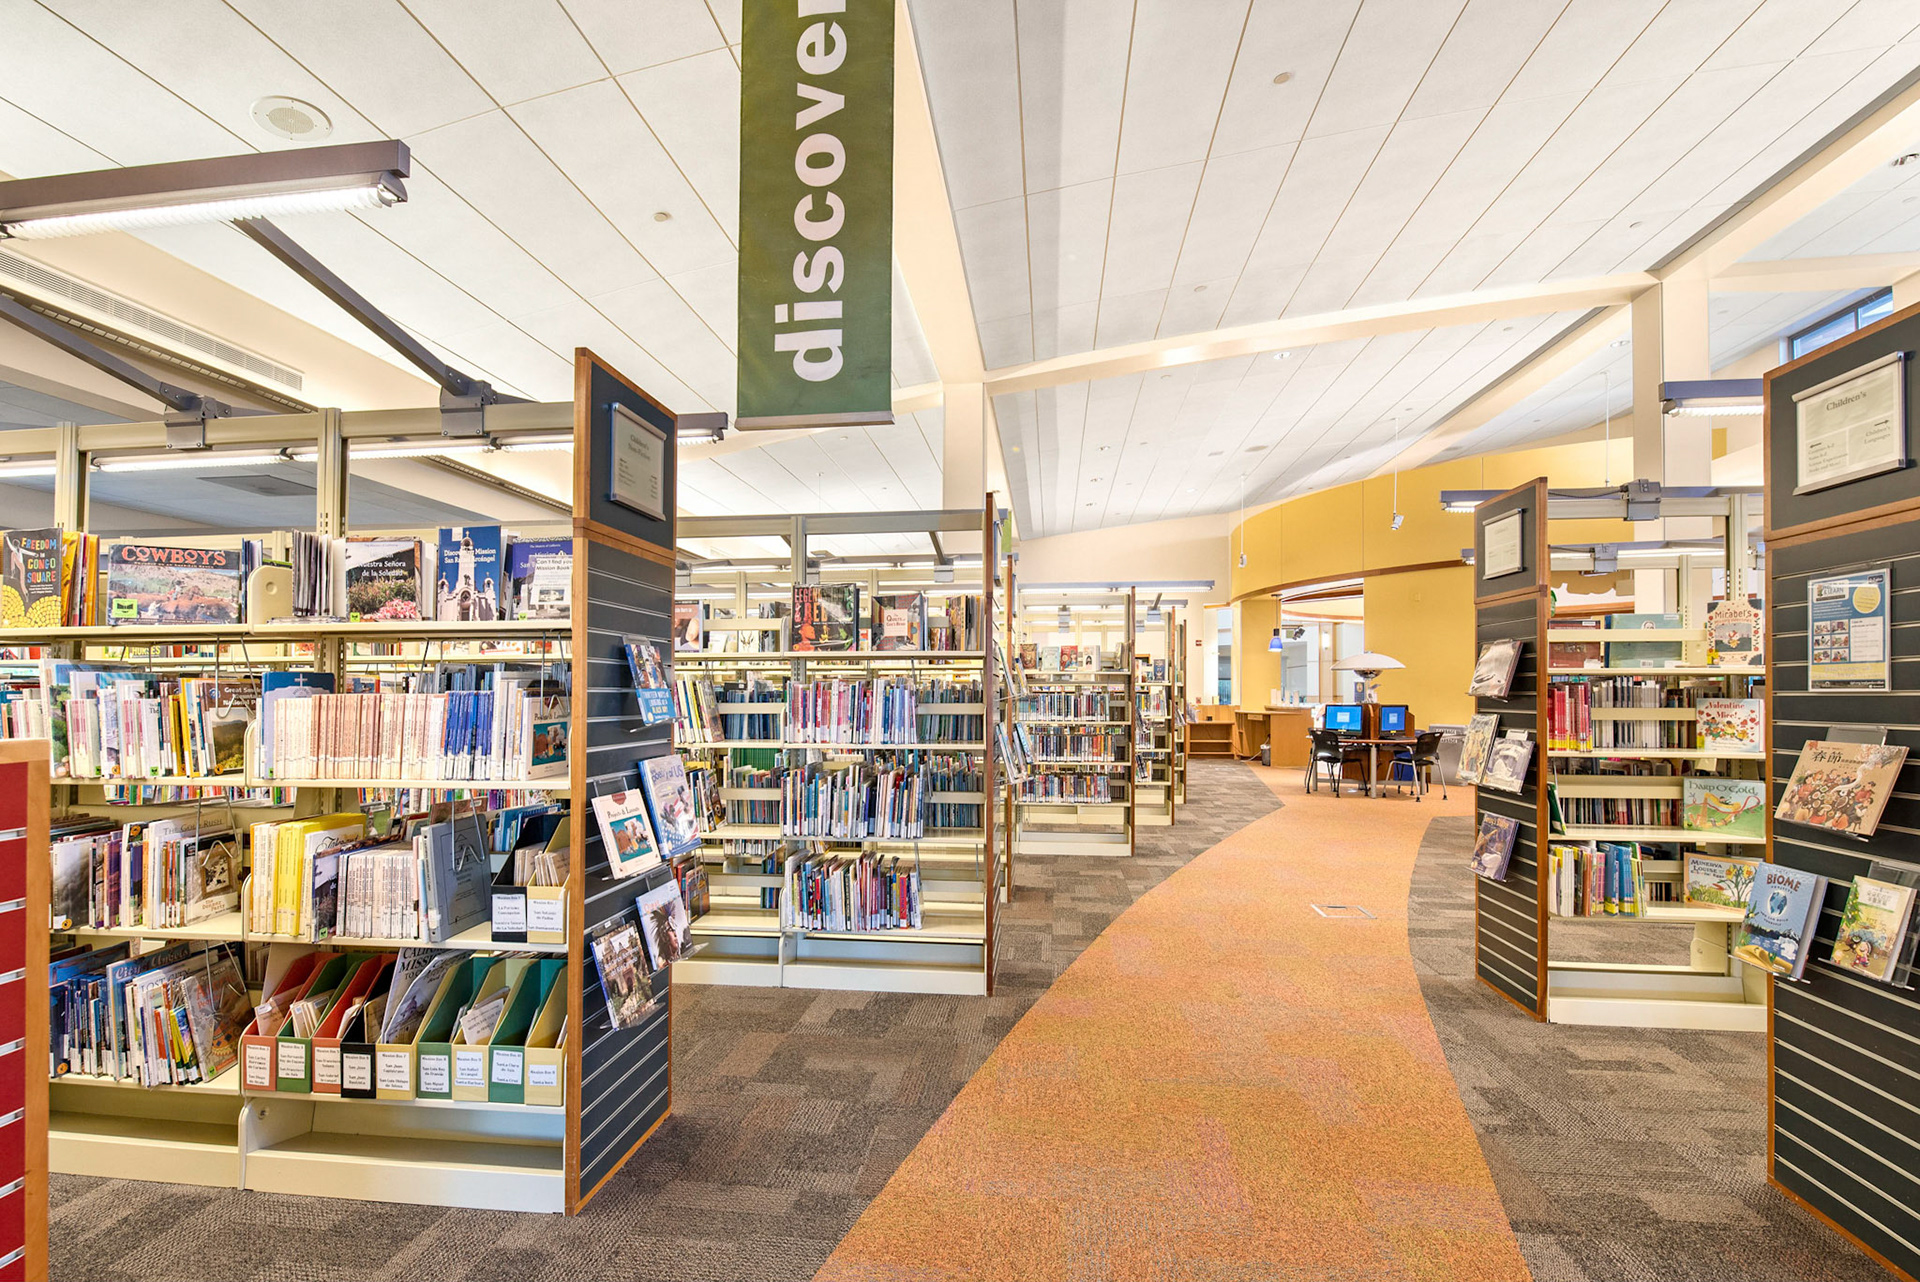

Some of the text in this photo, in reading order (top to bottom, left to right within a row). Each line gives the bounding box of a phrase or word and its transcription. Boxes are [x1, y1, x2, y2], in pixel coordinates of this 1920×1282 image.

[1826, 390, 1868, 411] Children's
[21, 538, 57, 550] FREEDOM
[122, 546, 226, 566] COWBOYS
[27, 558, 56, 570] CONGO
[26, 570, 56, 584] SQUARE
[1714, 610, 1752, 619] Mirabel's
[1708, 702, 1745, 710] Valentine
[1716, 710, 1738, 719] Mice!
[181, 823, 200, 832] GOL
[1690, 859, 1723, 869] MINERVA
[1693, 866, 1718, 874] LOUISE
[401, 954, 437, 971] MISSI
